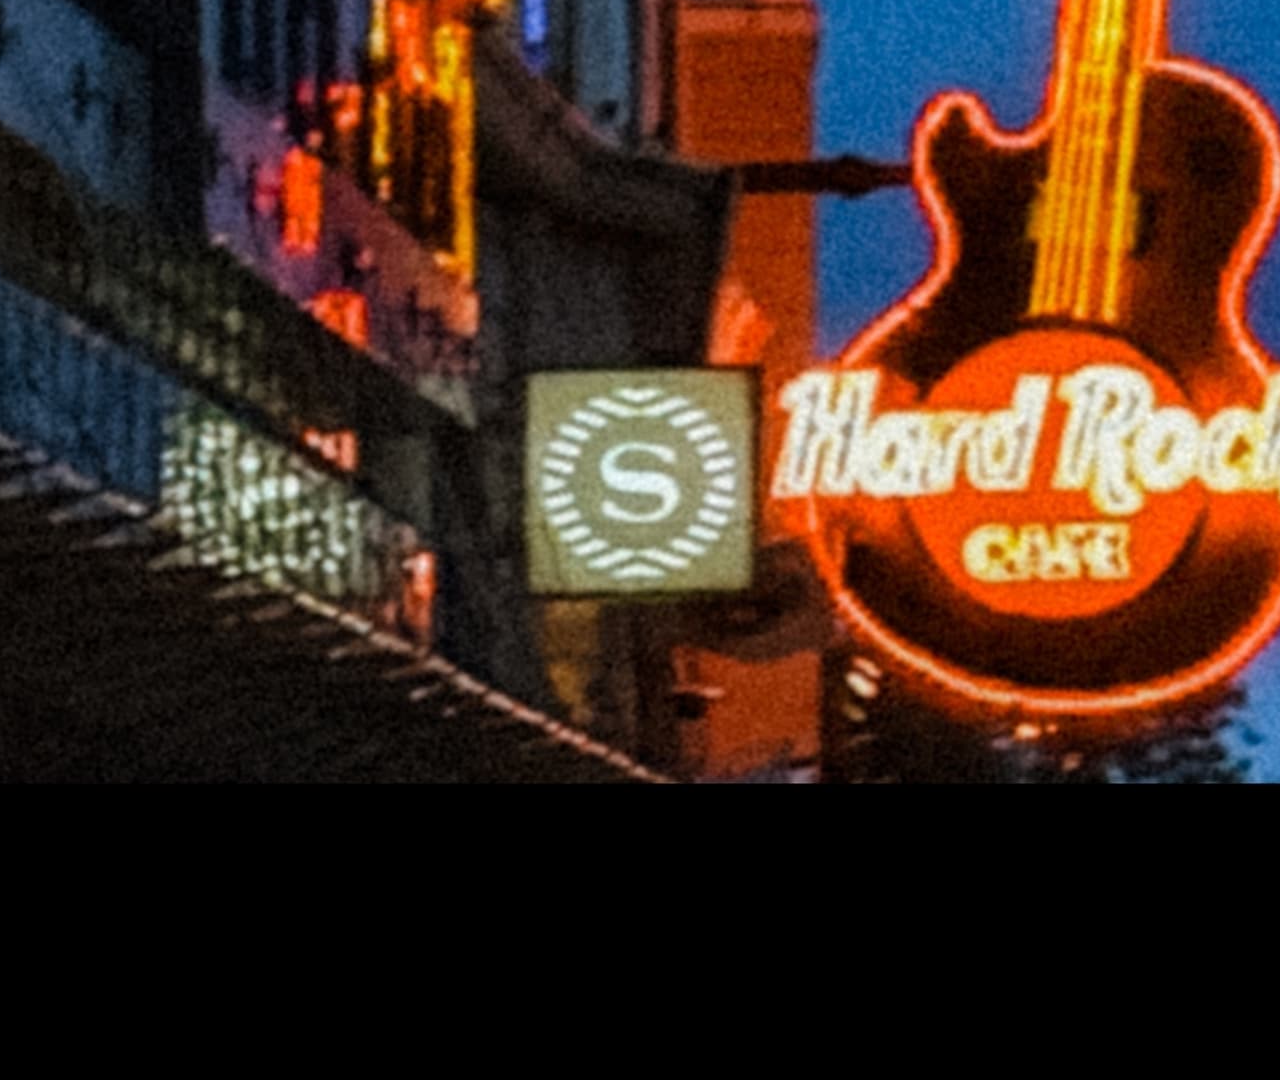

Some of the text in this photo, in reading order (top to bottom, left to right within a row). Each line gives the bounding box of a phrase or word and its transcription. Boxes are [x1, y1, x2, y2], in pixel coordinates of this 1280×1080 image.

[770, 366, 1054, 500] Hard
[599, 441, 681, 523] S
[961, 522, 1132, 583] CAFE
